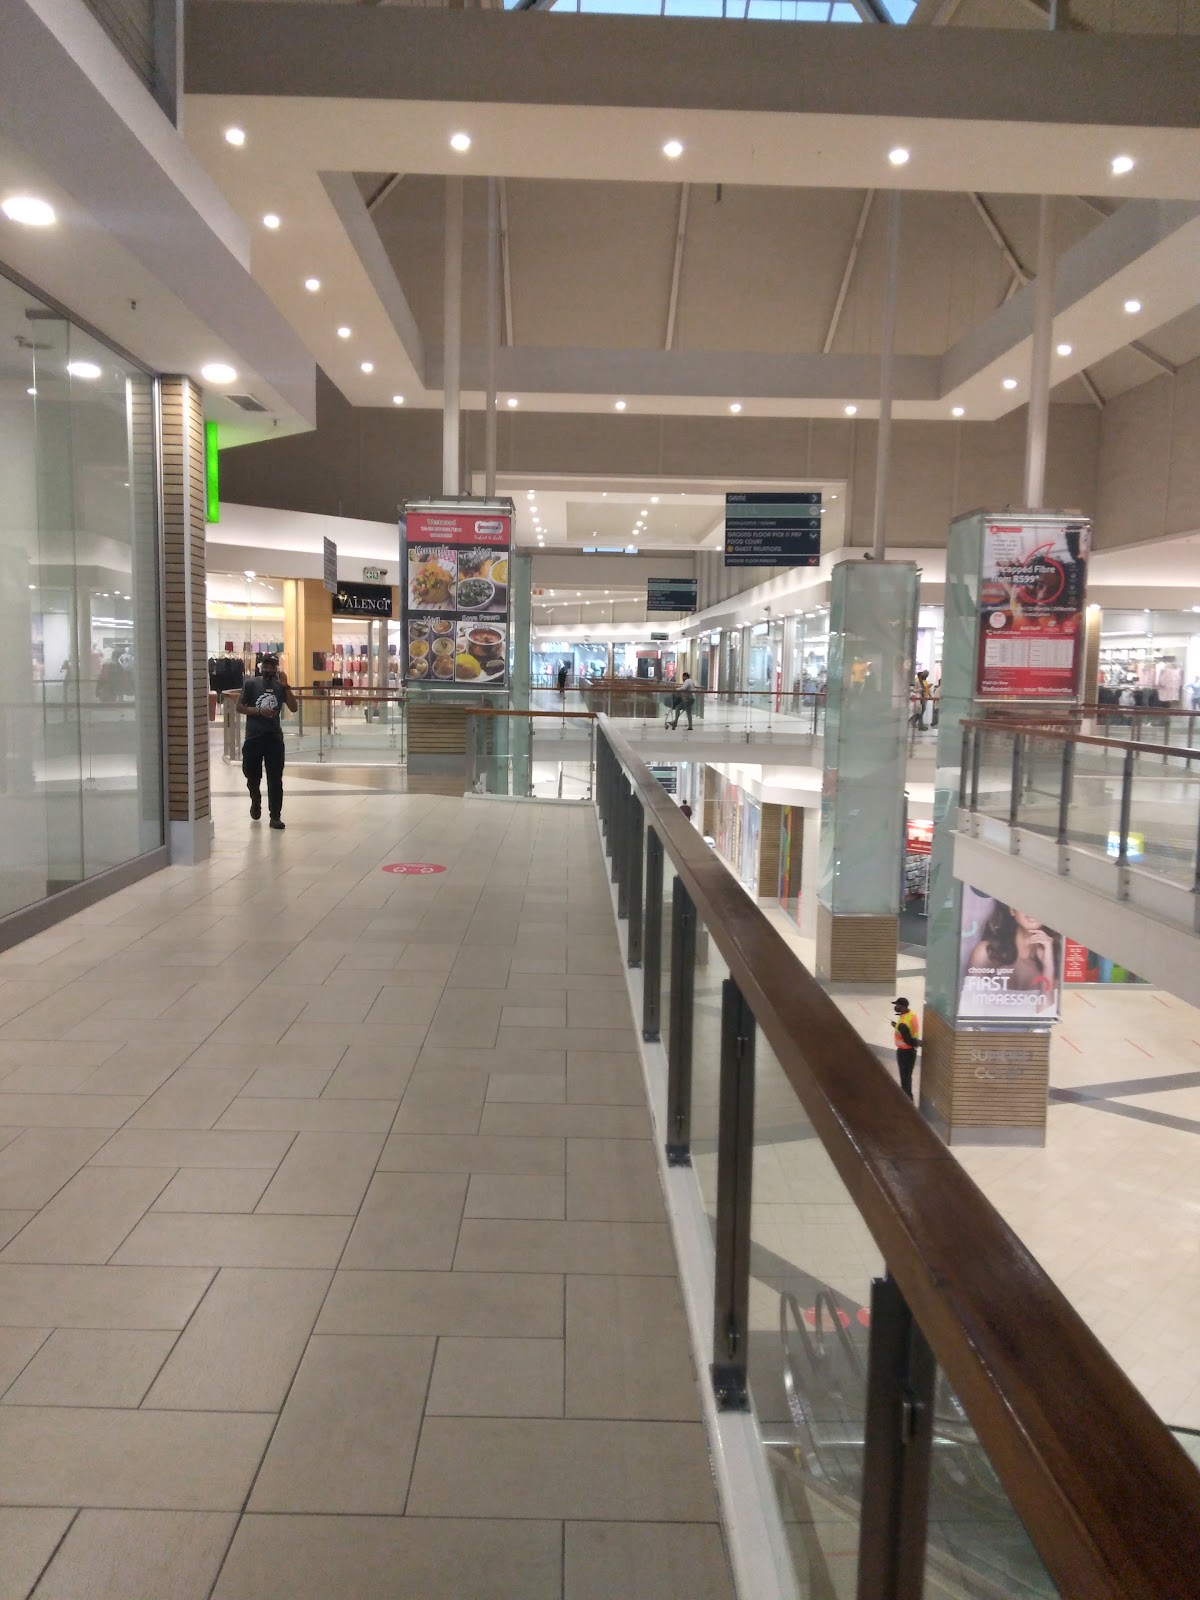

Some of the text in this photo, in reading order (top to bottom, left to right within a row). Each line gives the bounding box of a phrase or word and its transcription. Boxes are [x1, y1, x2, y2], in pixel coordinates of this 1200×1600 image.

[993, 565, 1056, 575] ncapped Fibre
[991, 575, 1012, 583] from
[968, 966, 1014, 976] choose your
[966, 976, 1010, 991] FIRST
